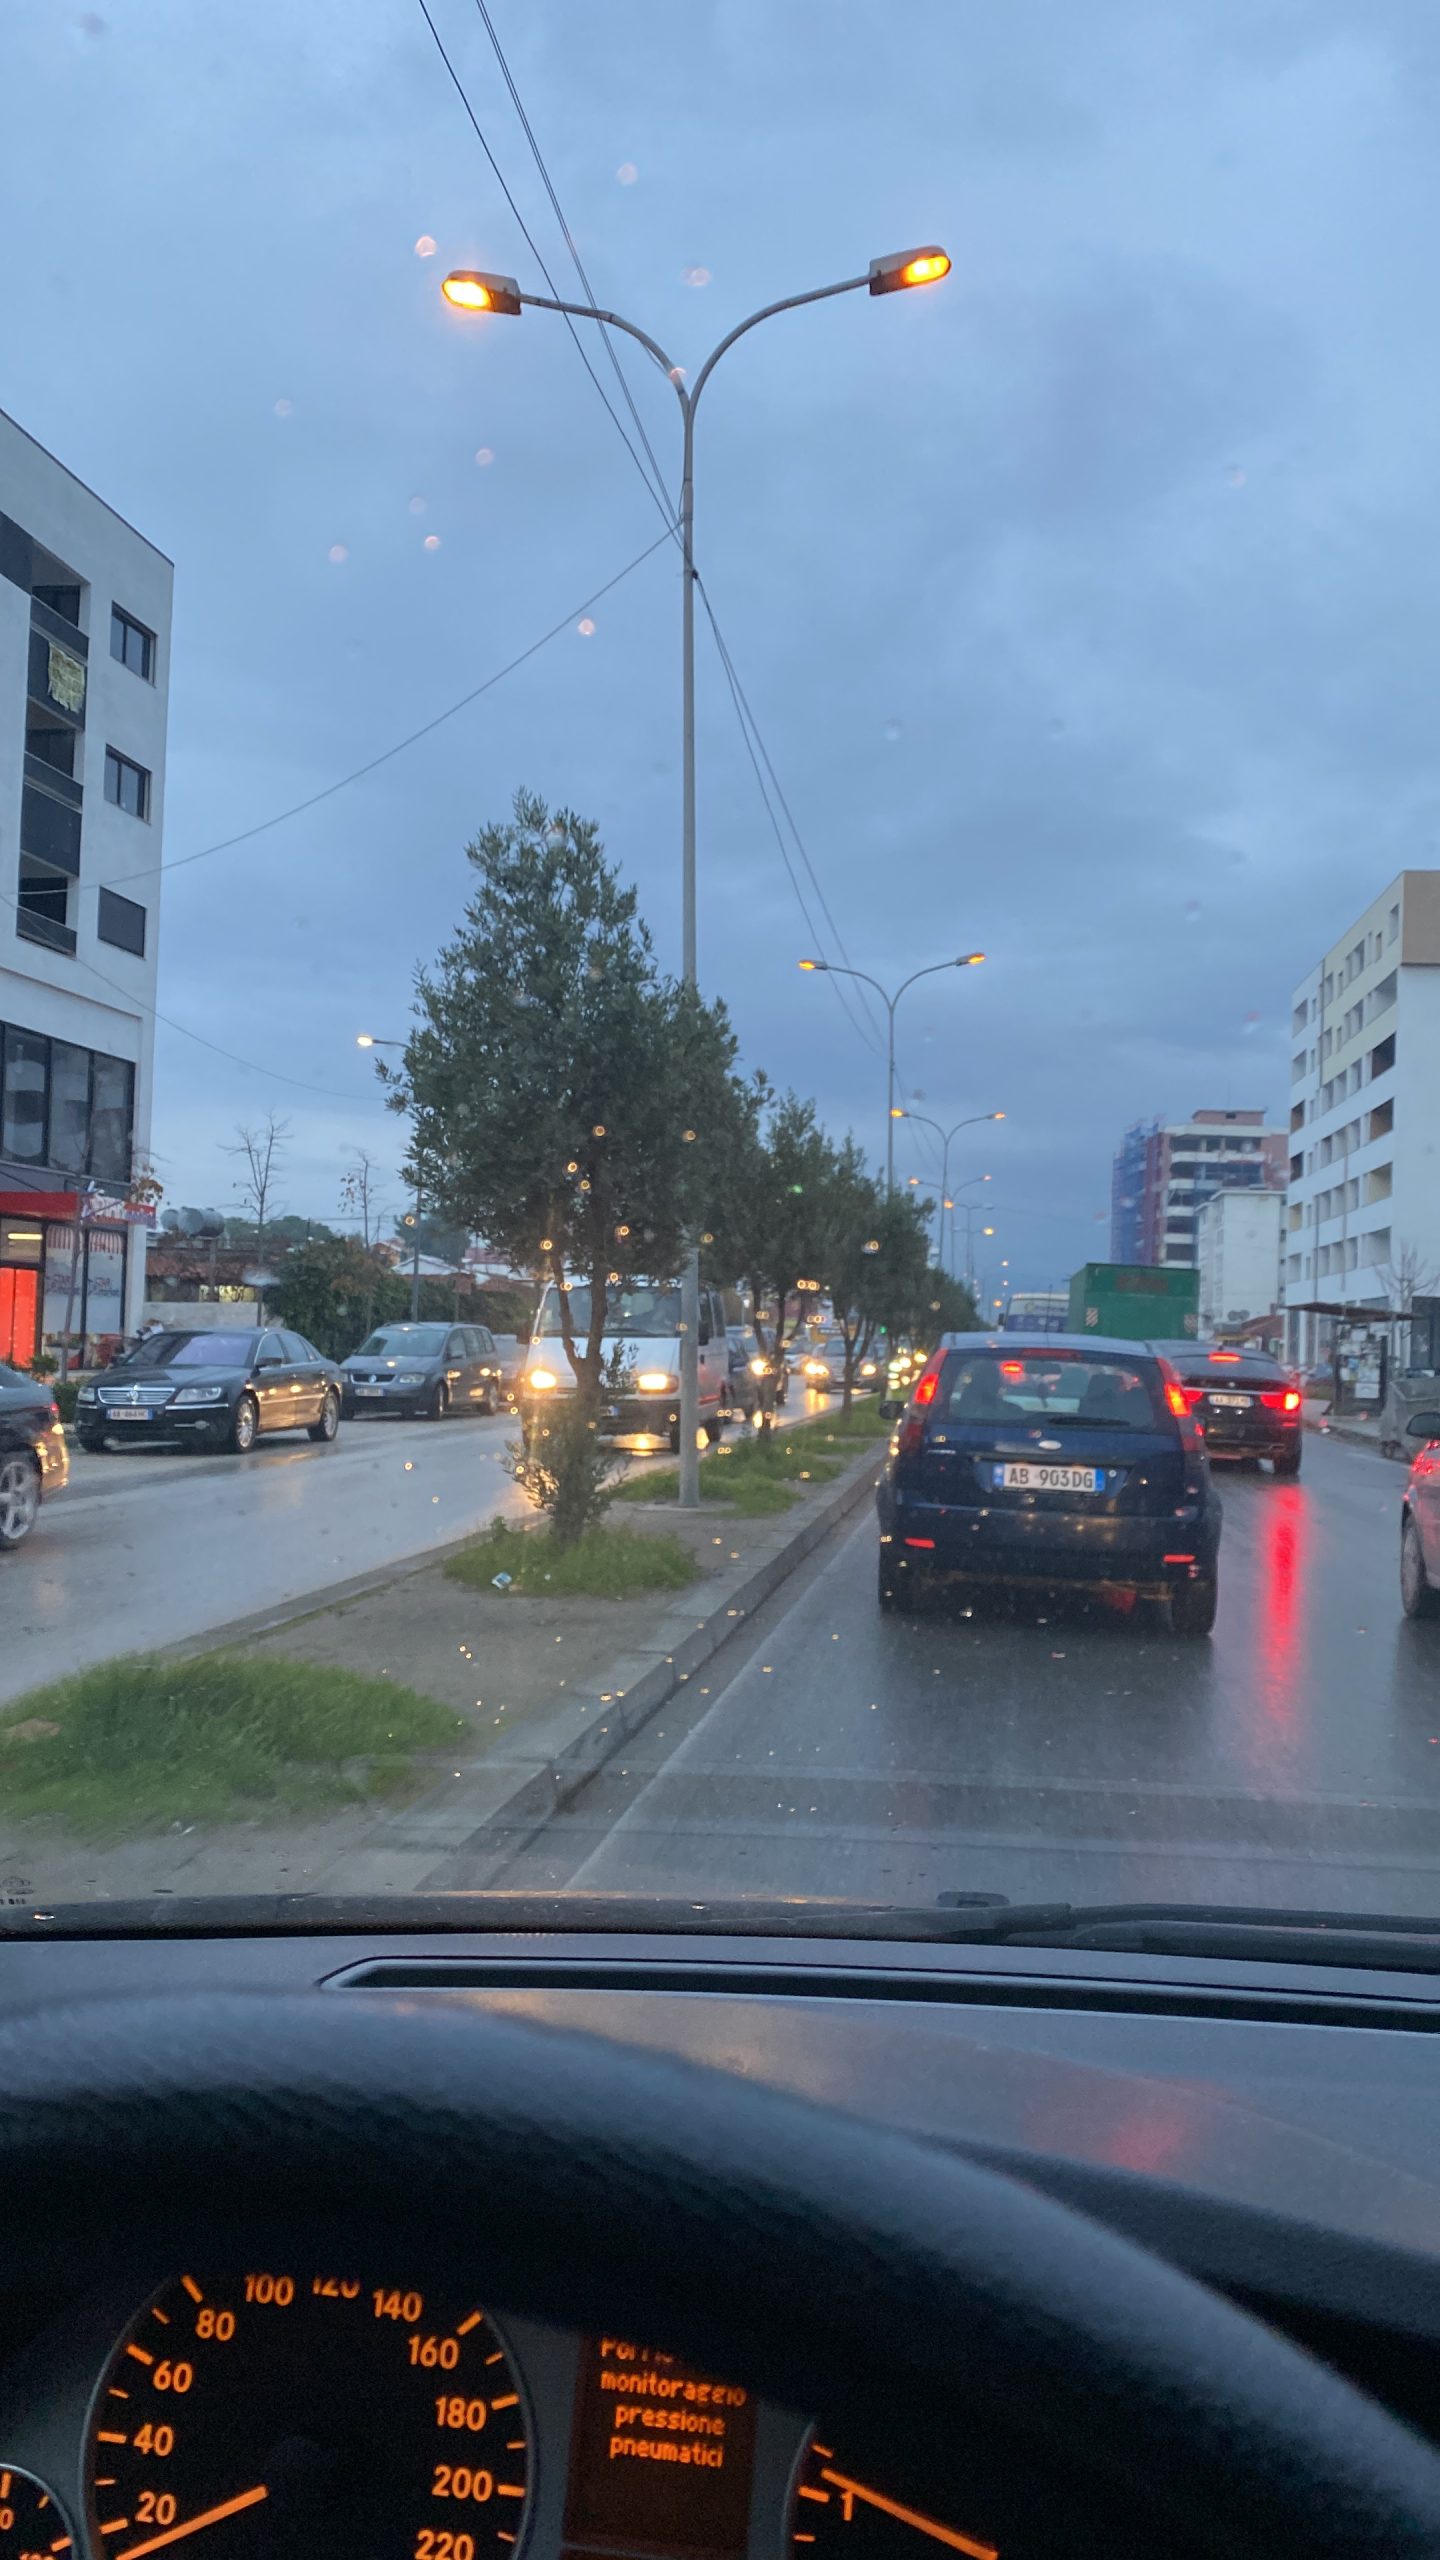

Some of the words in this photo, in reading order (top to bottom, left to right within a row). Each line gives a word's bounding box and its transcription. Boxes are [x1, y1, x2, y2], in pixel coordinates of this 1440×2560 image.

[1009, 1467, 1030, 1485] AB
[1039, 1468, 1094, 1489] 903DG
[245, 2274, 294, 2306] 100
[373, 2289, 422, 2322] 140
[196, 2309, 235, 2341] 80
[408, 2336, 460, 2369] 160
[153, 2360, 193, 2393] 60
[600, 2370, 747, 2407] monitoraggio
[435, 2396, 487, 2431] 180
[615, 2404, 726, 2435] pressione
[133, 2423, 174, 2457] 40
[610, 2435, 724, 2468] pneumatici
[431, 2464, 493, 2502] 200
[135, 2491, 177, 2526] 20
[841, 2491, 854, 2522] 1
[414, 2529, 475, 2560] 220
